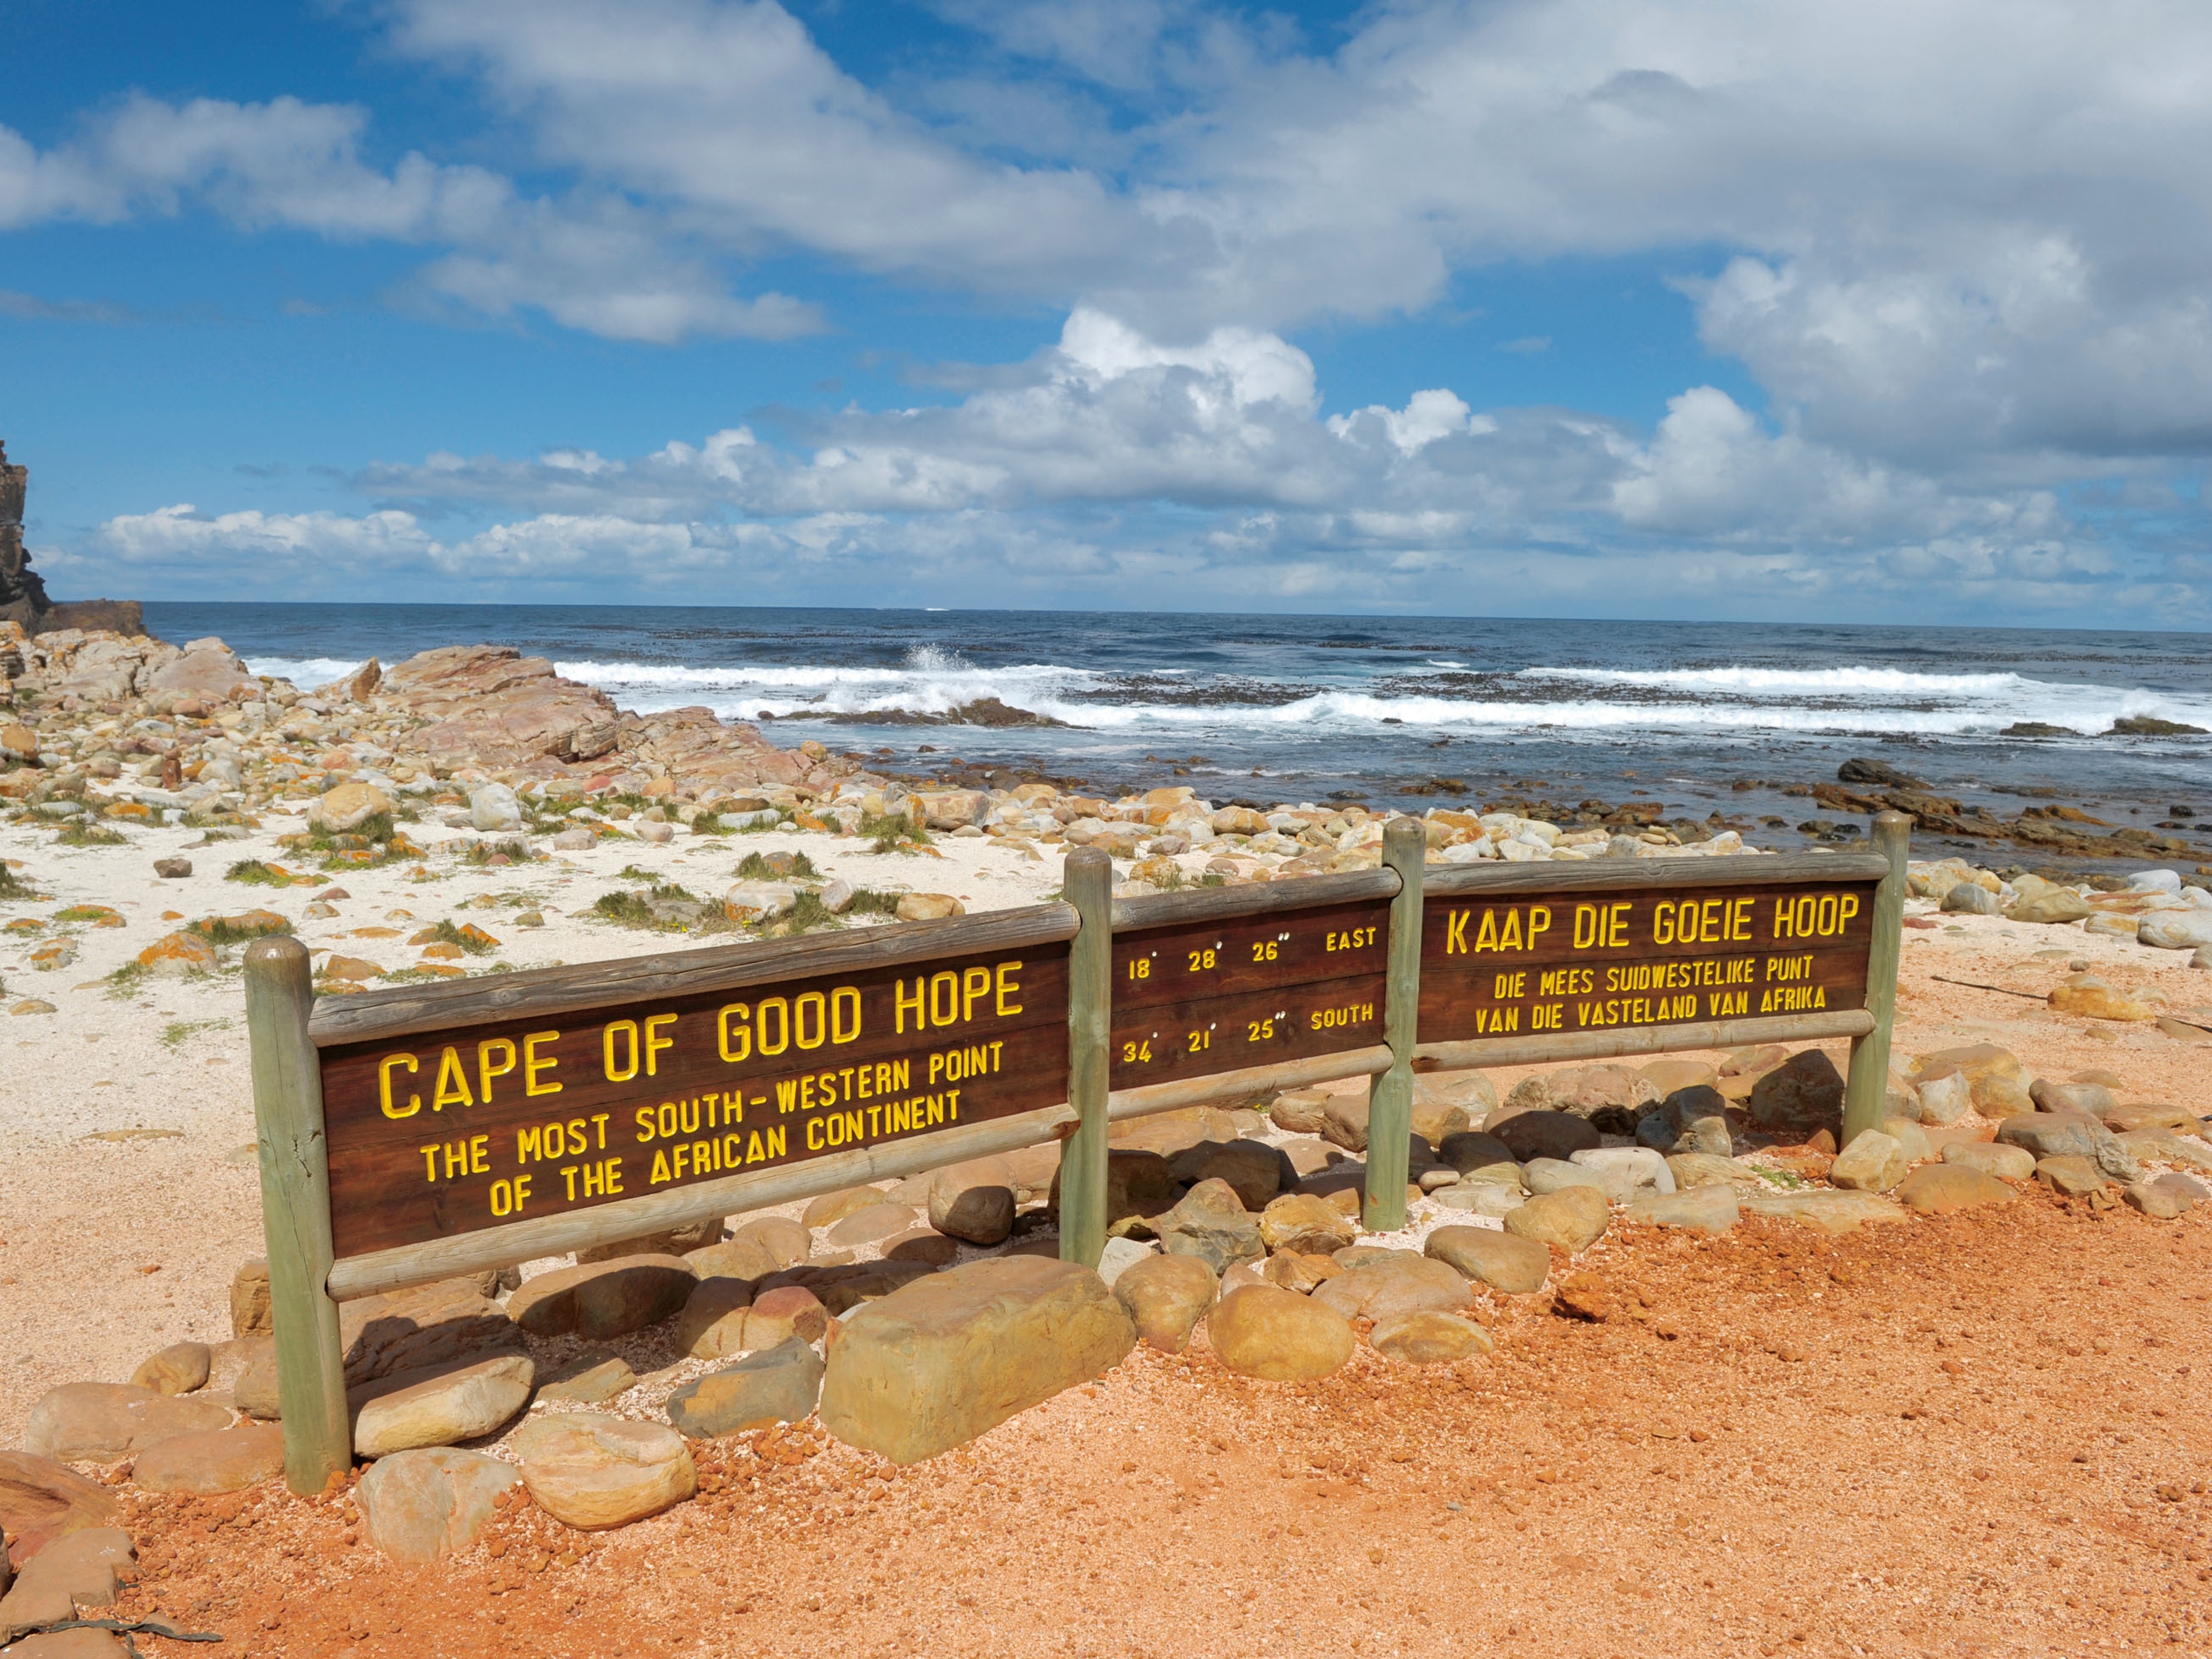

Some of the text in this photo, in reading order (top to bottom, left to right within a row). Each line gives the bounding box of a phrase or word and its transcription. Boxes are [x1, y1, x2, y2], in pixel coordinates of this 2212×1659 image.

[1326, 927, 1377, 952] EAST
[1446, 894, 1860, 955] KAAP DIE GOEIE HOOP
[1494, 955, 1814, 999] DIE MEES SUIDWESTELIKE PUNT
[1311, 1003, 1373, 1031] SOUTH
[1476, 986, 1826, 1033] VAN DIE VASTELAND VAN AFRIKA
[378, 960, 1024, 1120] CAPE OF GOOD HOPE
[420, 1134, 490, 1182] THE
[517, 1112, 610, 1165] MOST
[929, 1041, 1004, 1085] POINT
[489, 1089, 960, 1216] OF THE AFRICAN CONTINENT
